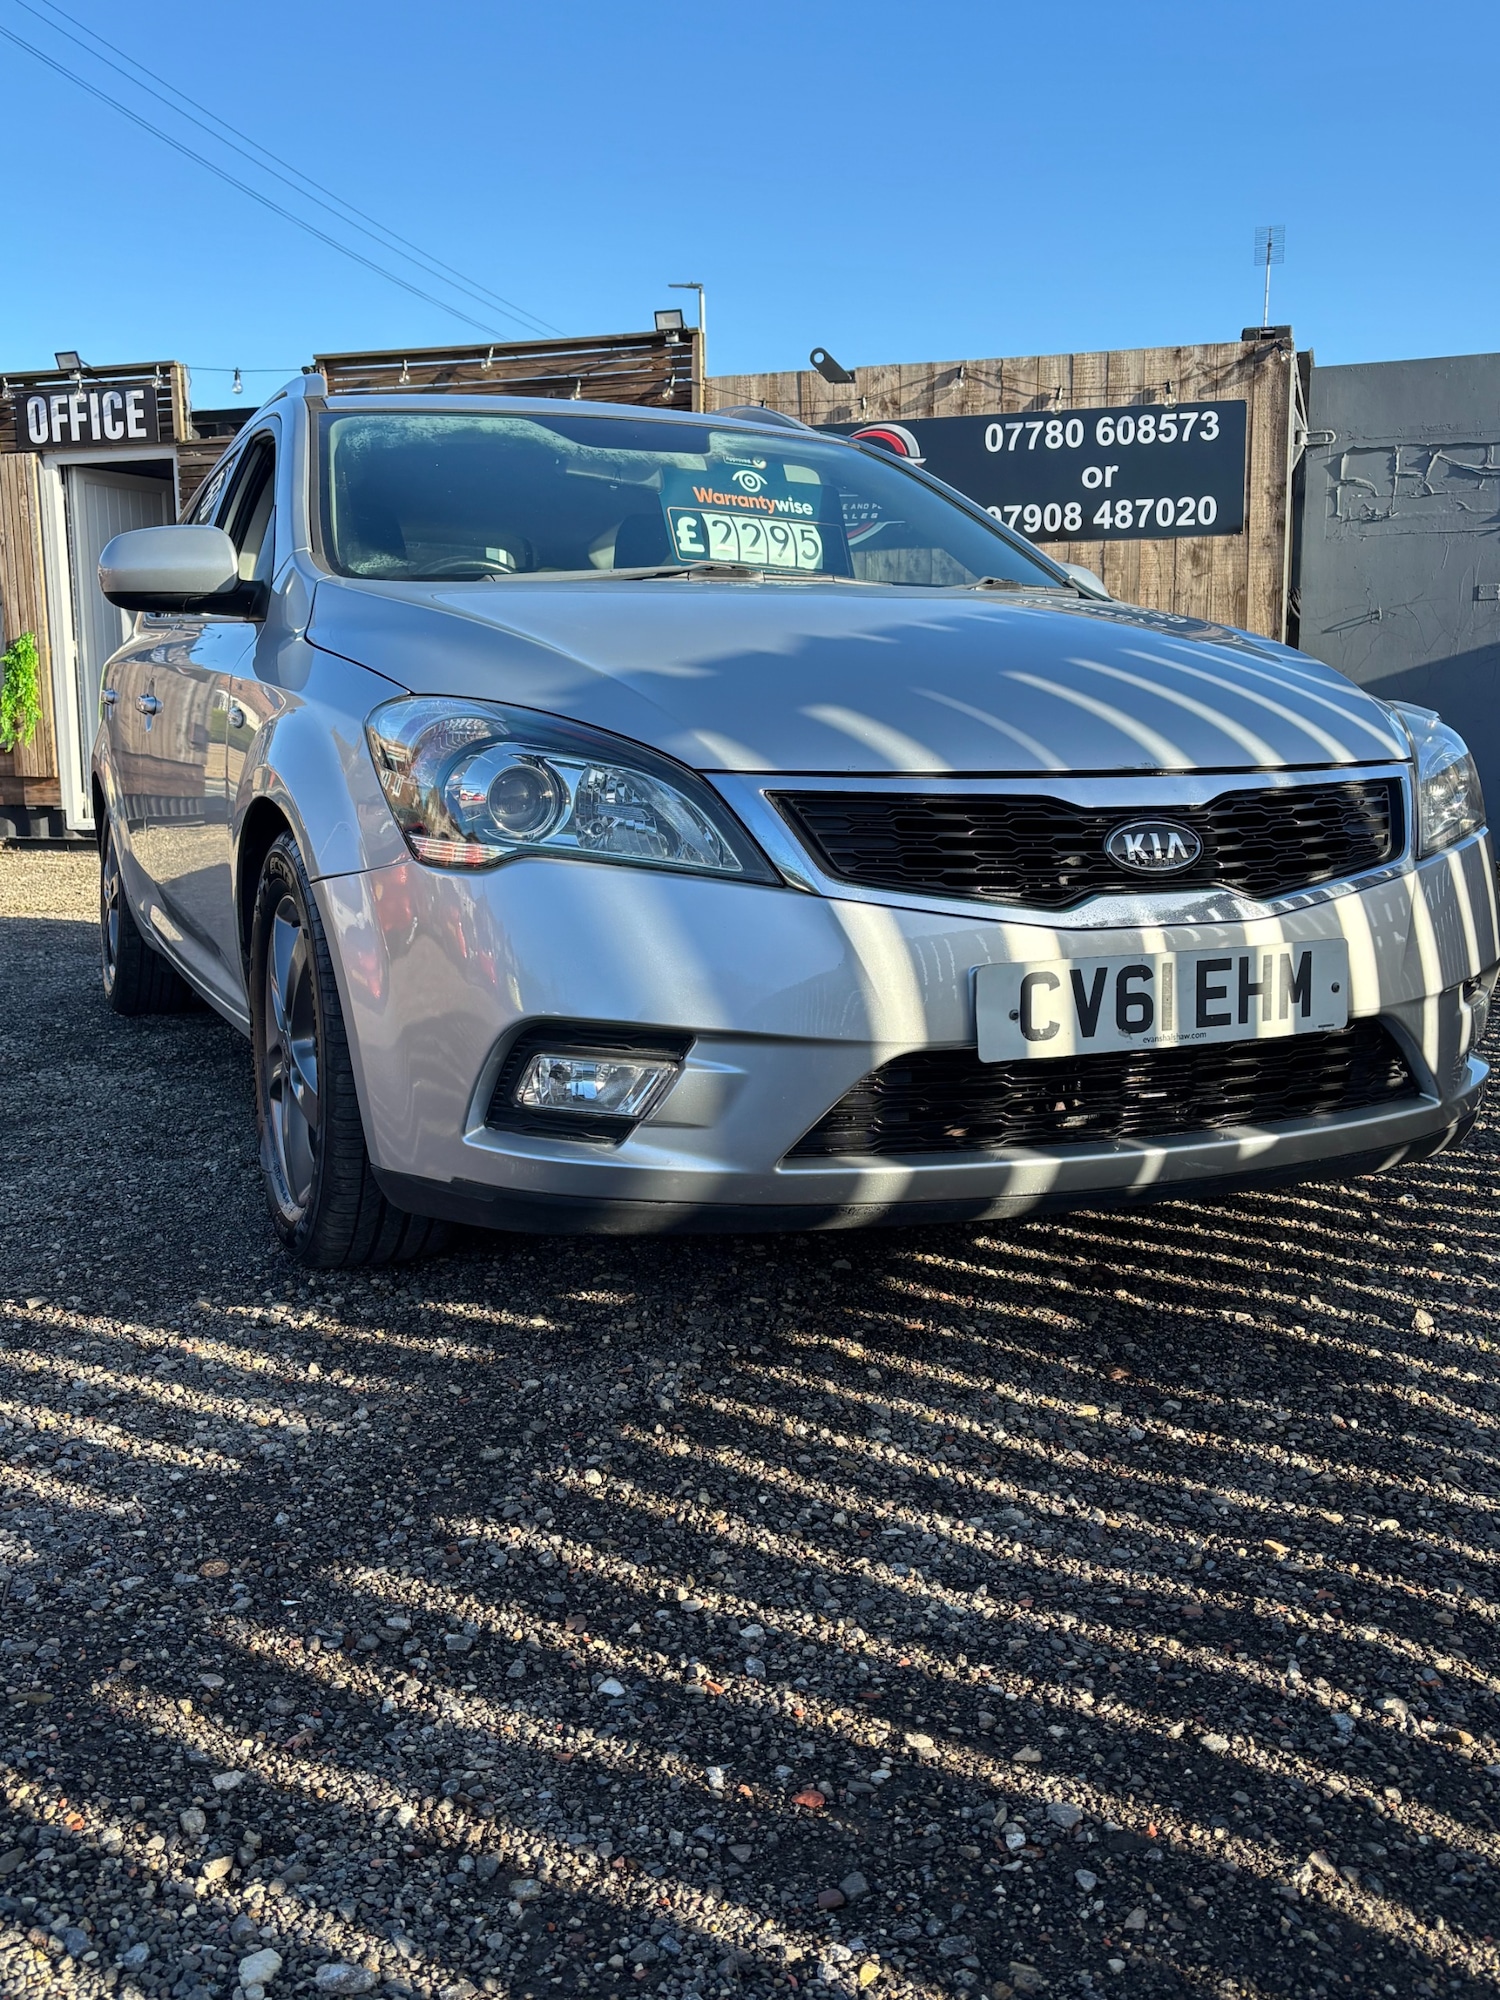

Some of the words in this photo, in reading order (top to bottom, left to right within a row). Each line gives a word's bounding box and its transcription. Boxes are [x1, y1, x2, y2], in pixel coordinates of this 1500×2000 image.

[27, 389, 147, 444] OFFICE
[985, 418, 1084, 452] 07780
[1096, 410, 1220, 446] 608573
[1081, 464, 1119, 489] or
[692, 486, 813, 515] Warrantywise
[1093, 496, 1217, 530] 487020
[676, 516, 820, 560] £2295
[1122, 832, 1189, 860] KIA
[1020, 962, 1173, 1042] CV61
[1196, 951, 1312, 1028] EHM
